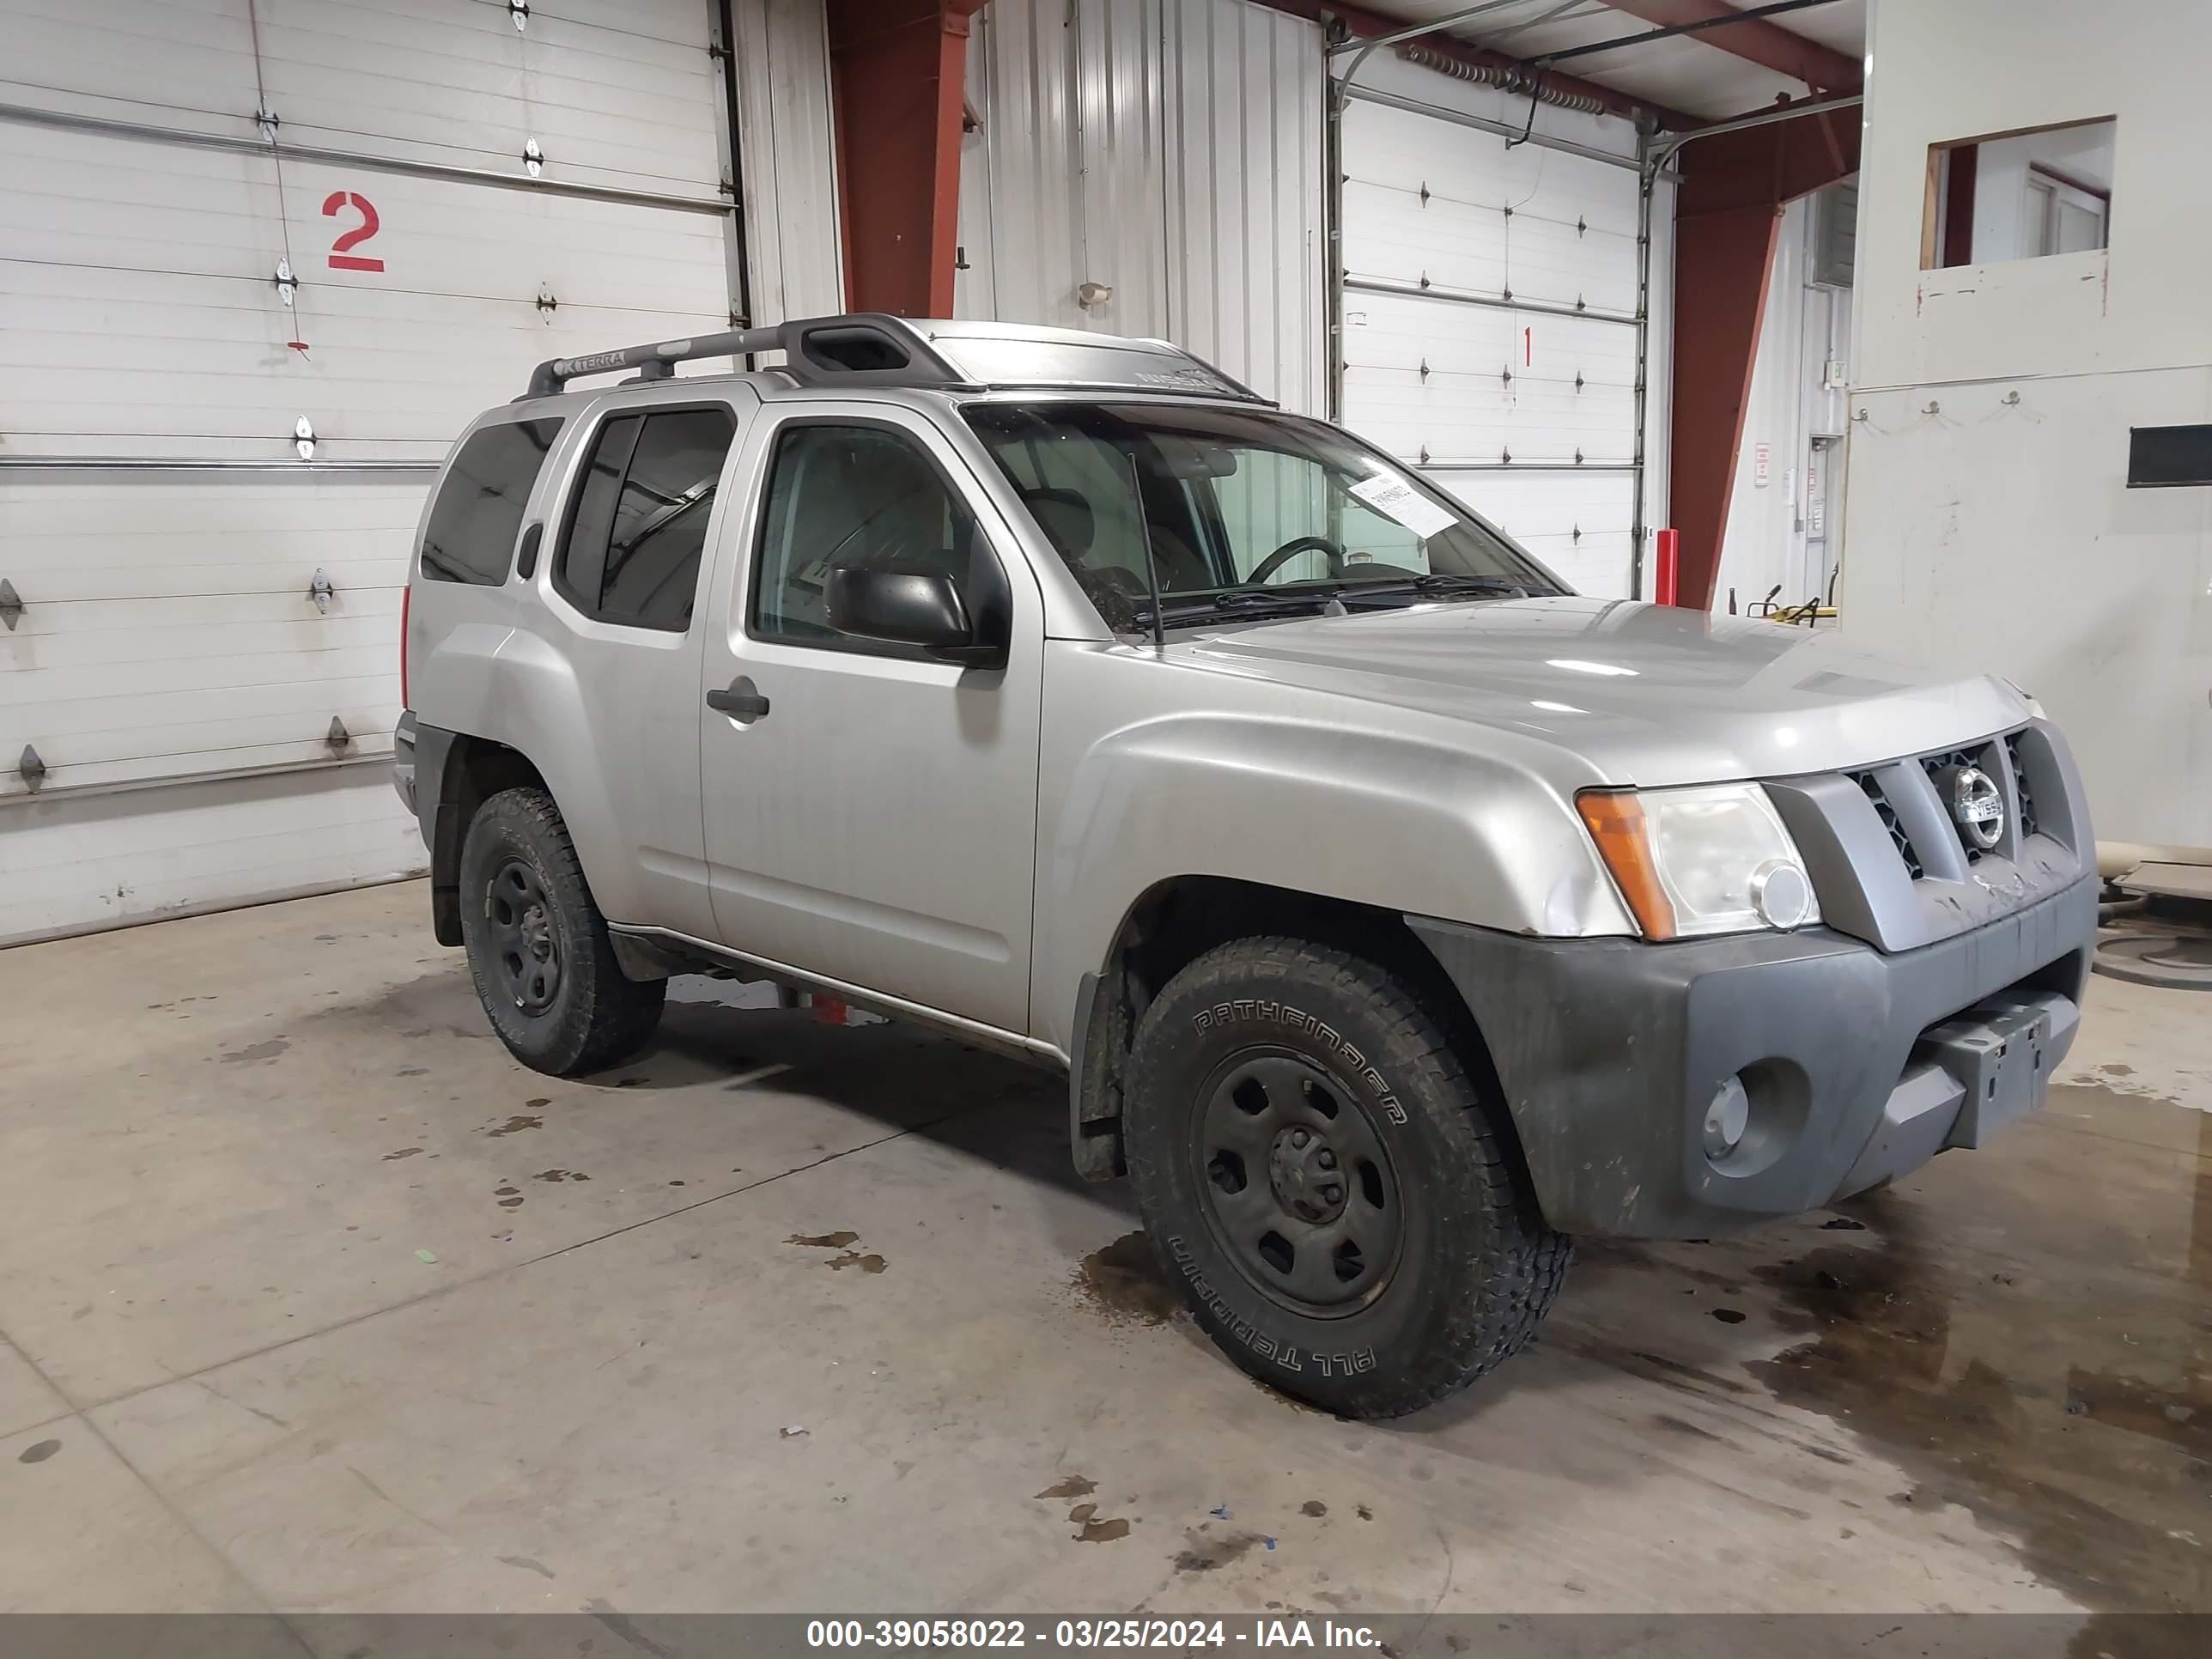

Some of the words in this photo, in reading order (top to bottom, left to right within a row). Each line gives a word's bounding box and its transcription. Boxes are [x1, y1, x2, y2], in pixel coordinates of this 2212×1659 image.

[323, 192, 385, 272] 2
[1524, 326, 1531, 368] 1
[1193, 1000, 1407, 1126] PATHFINDER
[1168, 1236, 1302, 1372] TERRAIN
[1312, 1346, 1376, 1376] ALL
